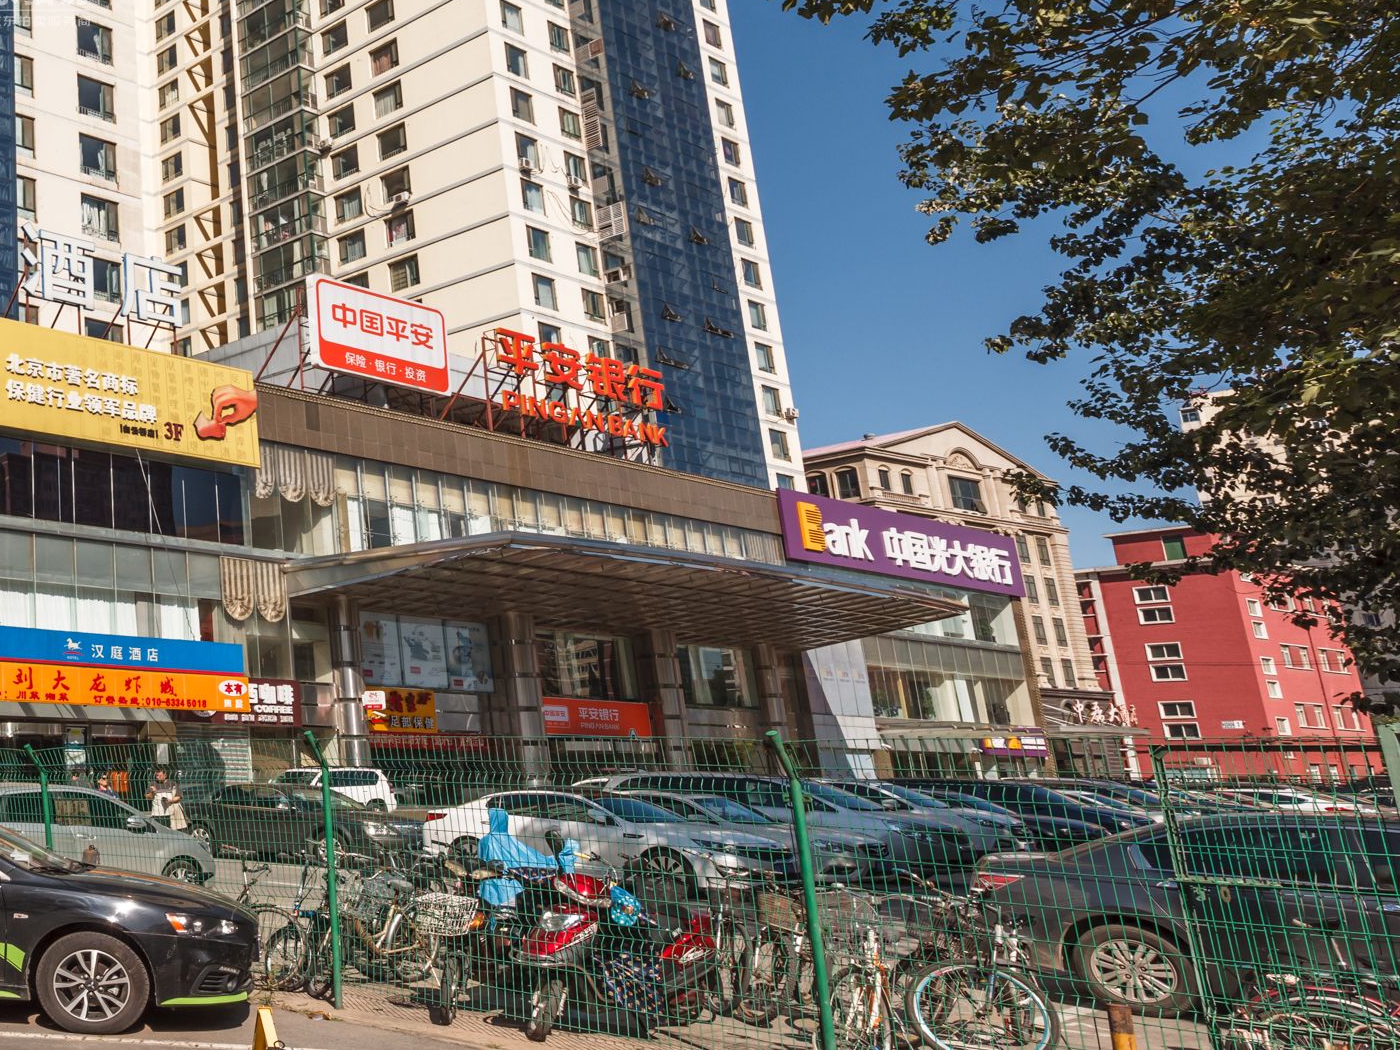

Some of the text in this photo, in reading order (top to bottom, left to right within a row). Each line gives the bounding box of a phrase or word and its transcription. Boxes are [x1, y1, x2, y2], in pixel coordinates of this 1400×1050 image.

[331, 303, 434, 350] 中国平安
[5, 352, 139, 396] 北京市著名商标
[497, 327, 665, 411] 平安银行
[5, 378, 158, 424] 保健行业领军品牌
[163, 421, 184, 442] 3F
[797, 501, 874, 561] Bank
[882, 527, 1014, 585] 中国光大银行
[91, 644, 159, 662] 汉庭酒店
[12, 666, 178, 697] 刘大龙虾城
[390, 714, 435, 730] 足部保健
[577, 707, 620, 722] 平安银行
